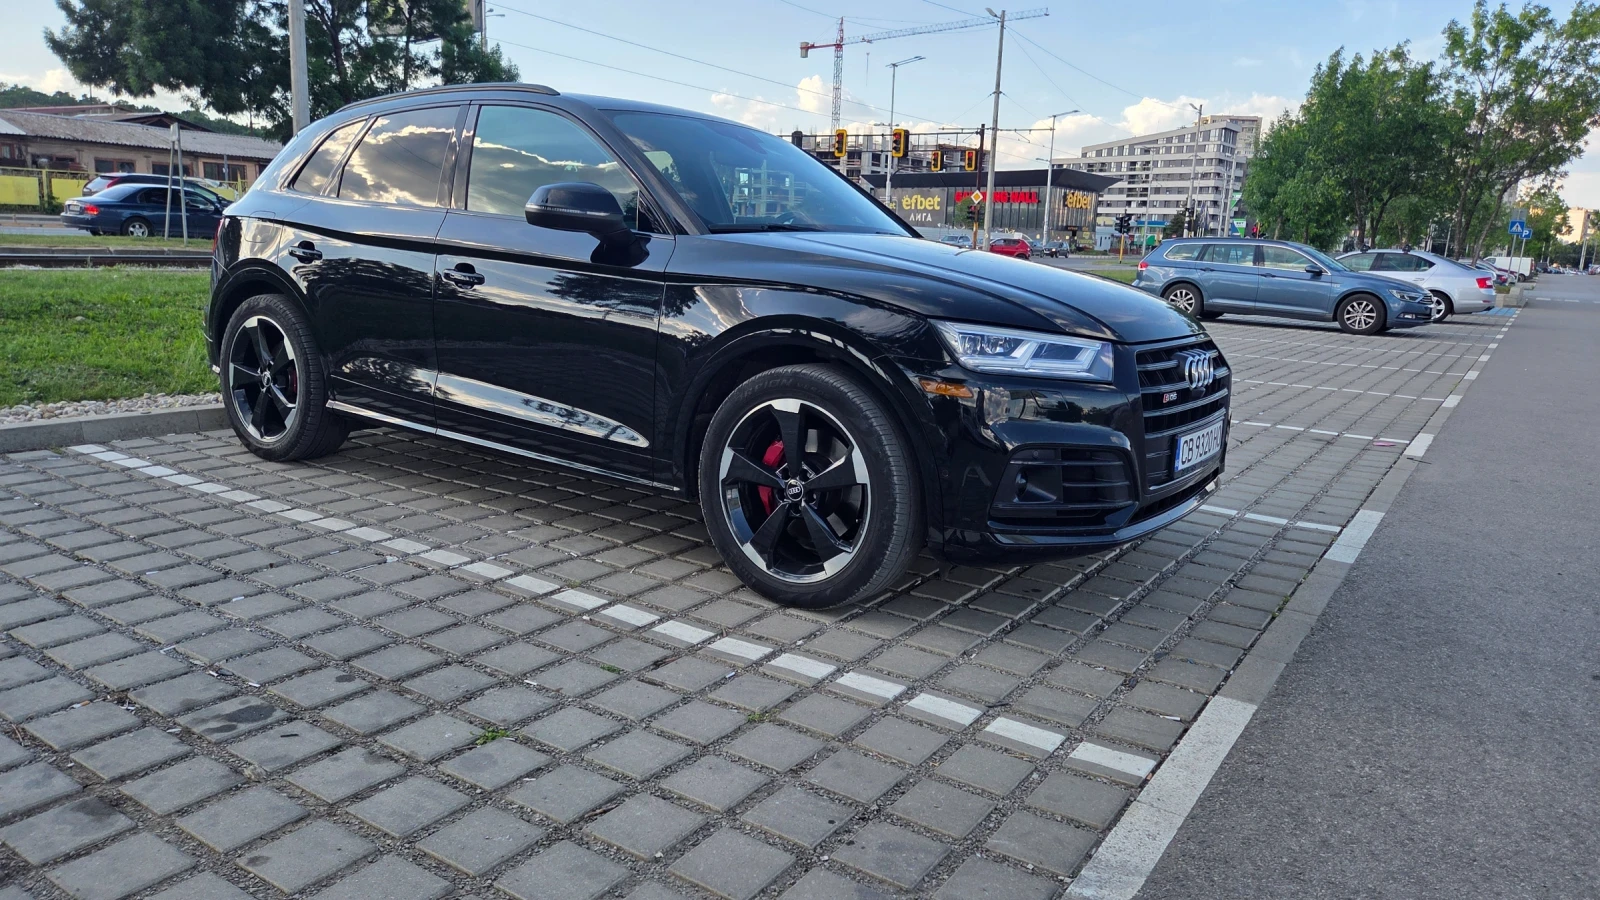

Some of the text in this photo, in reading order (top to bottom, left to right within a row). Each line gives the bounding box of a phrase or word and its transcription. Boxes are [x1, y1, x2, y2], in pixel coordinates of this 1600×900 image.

[902, 195, 941, 210] efbet
[1067, 192, 1091, 209] efbet
[909, 213, 932, 222] ЛИГА
